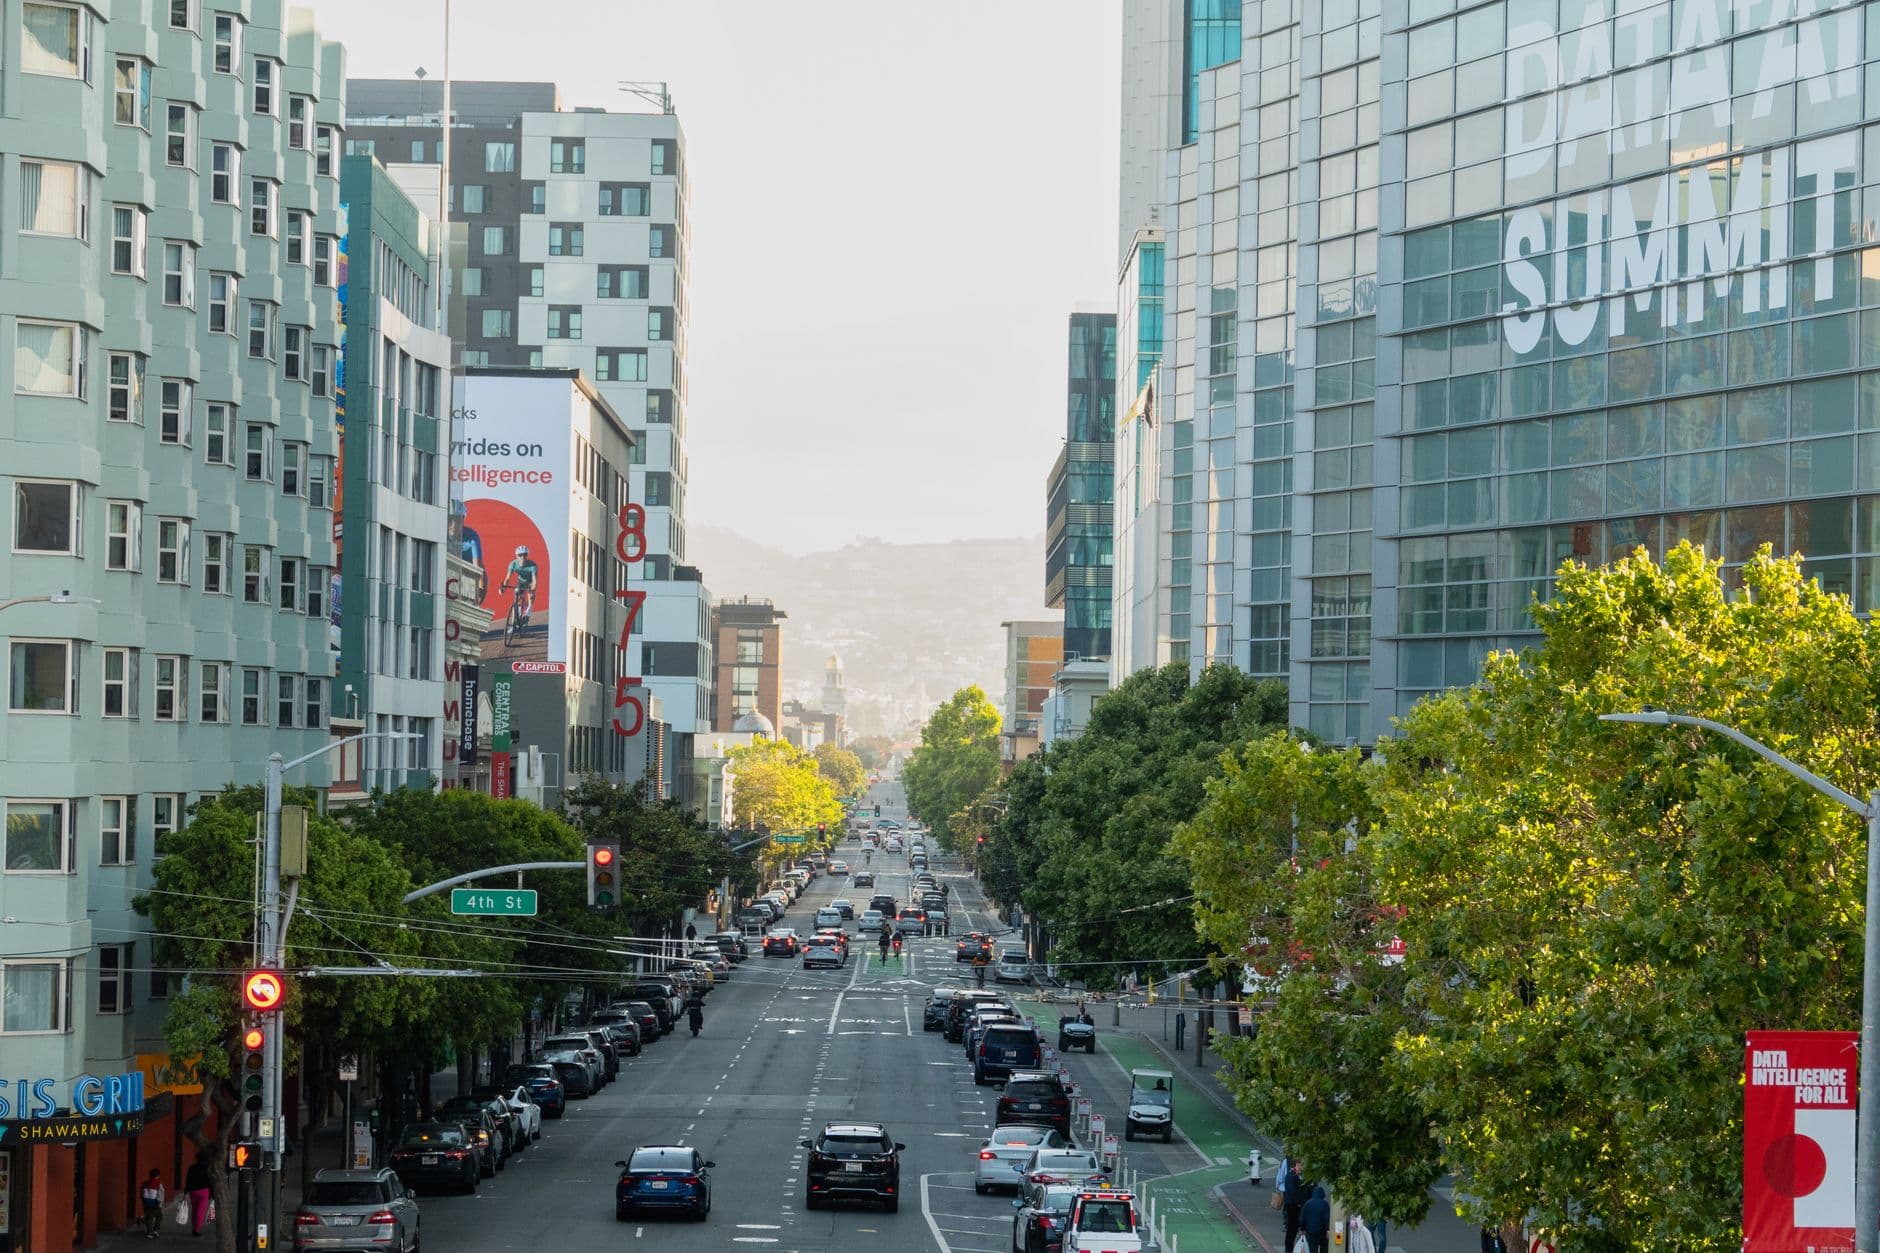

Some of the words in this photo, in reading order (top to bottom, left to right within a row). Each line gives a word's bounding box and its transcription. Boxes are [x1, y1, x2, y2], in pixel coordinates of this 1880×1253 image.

[1502, 131, 1857, 355] SUMMIT
[516, 443, 543, 458] on
[449, 464, 553, 488] telligence
[525, 663, 562, 673] CAPITOL
[464, 679, 476, 751] homebase
[494, 681, 503, 736] COMPUTERS
[501, 681, 510, 737] CENTRAL
[497, 761, 505, 778] THE
[467, 895, 494, 909] 4th
[505, 896, 523, 909] St
[1752, 1050, 1788, 1068] DATA
[1752, 1068, 1847, 1086] INTELLIGENCE
[1795, 1086, 1824, 1104] FOR
[1824, 1086, 1848, 1104] ALL
[20, 1123, 108, 1139] SHAWARMA
